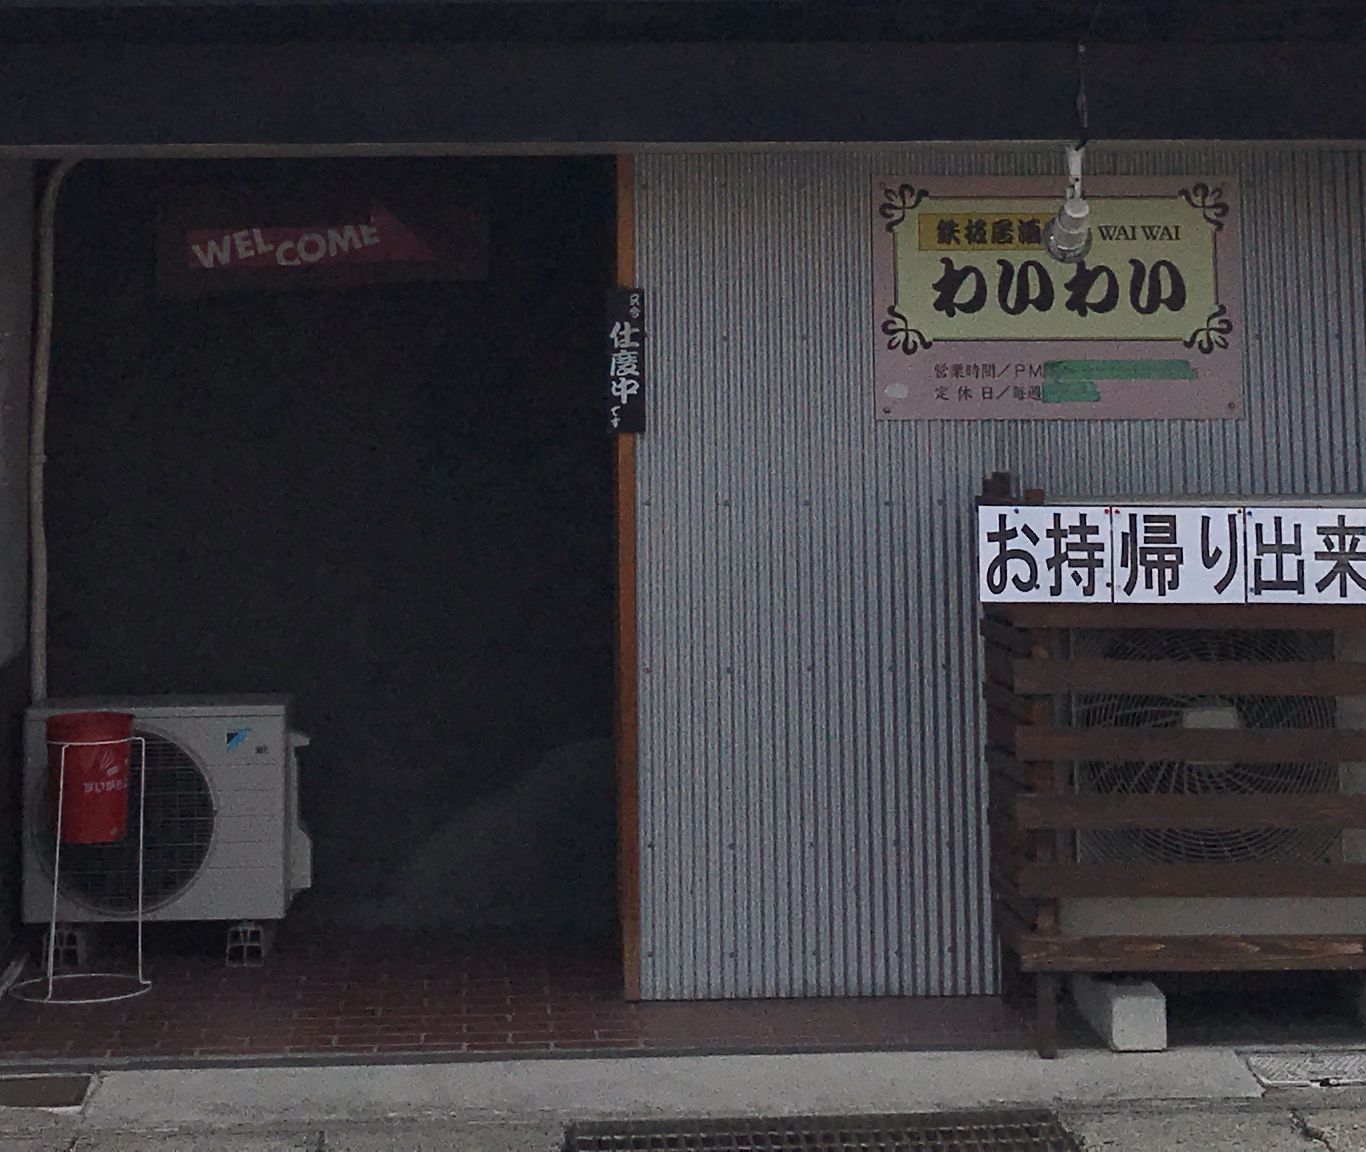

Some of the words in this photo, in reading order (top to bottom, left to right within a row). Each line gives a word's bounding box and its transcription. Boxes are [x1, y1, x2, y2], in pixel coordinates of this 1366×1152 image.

[191, 219, 380, 269] WELCOME
[936, 218, 1045, 246] 鉄板居酒
[1098, 224, 1137, 241] WAI
[1141, 224, 1182, 242] WAI
[932, 256, 1187, 318] わいわい
